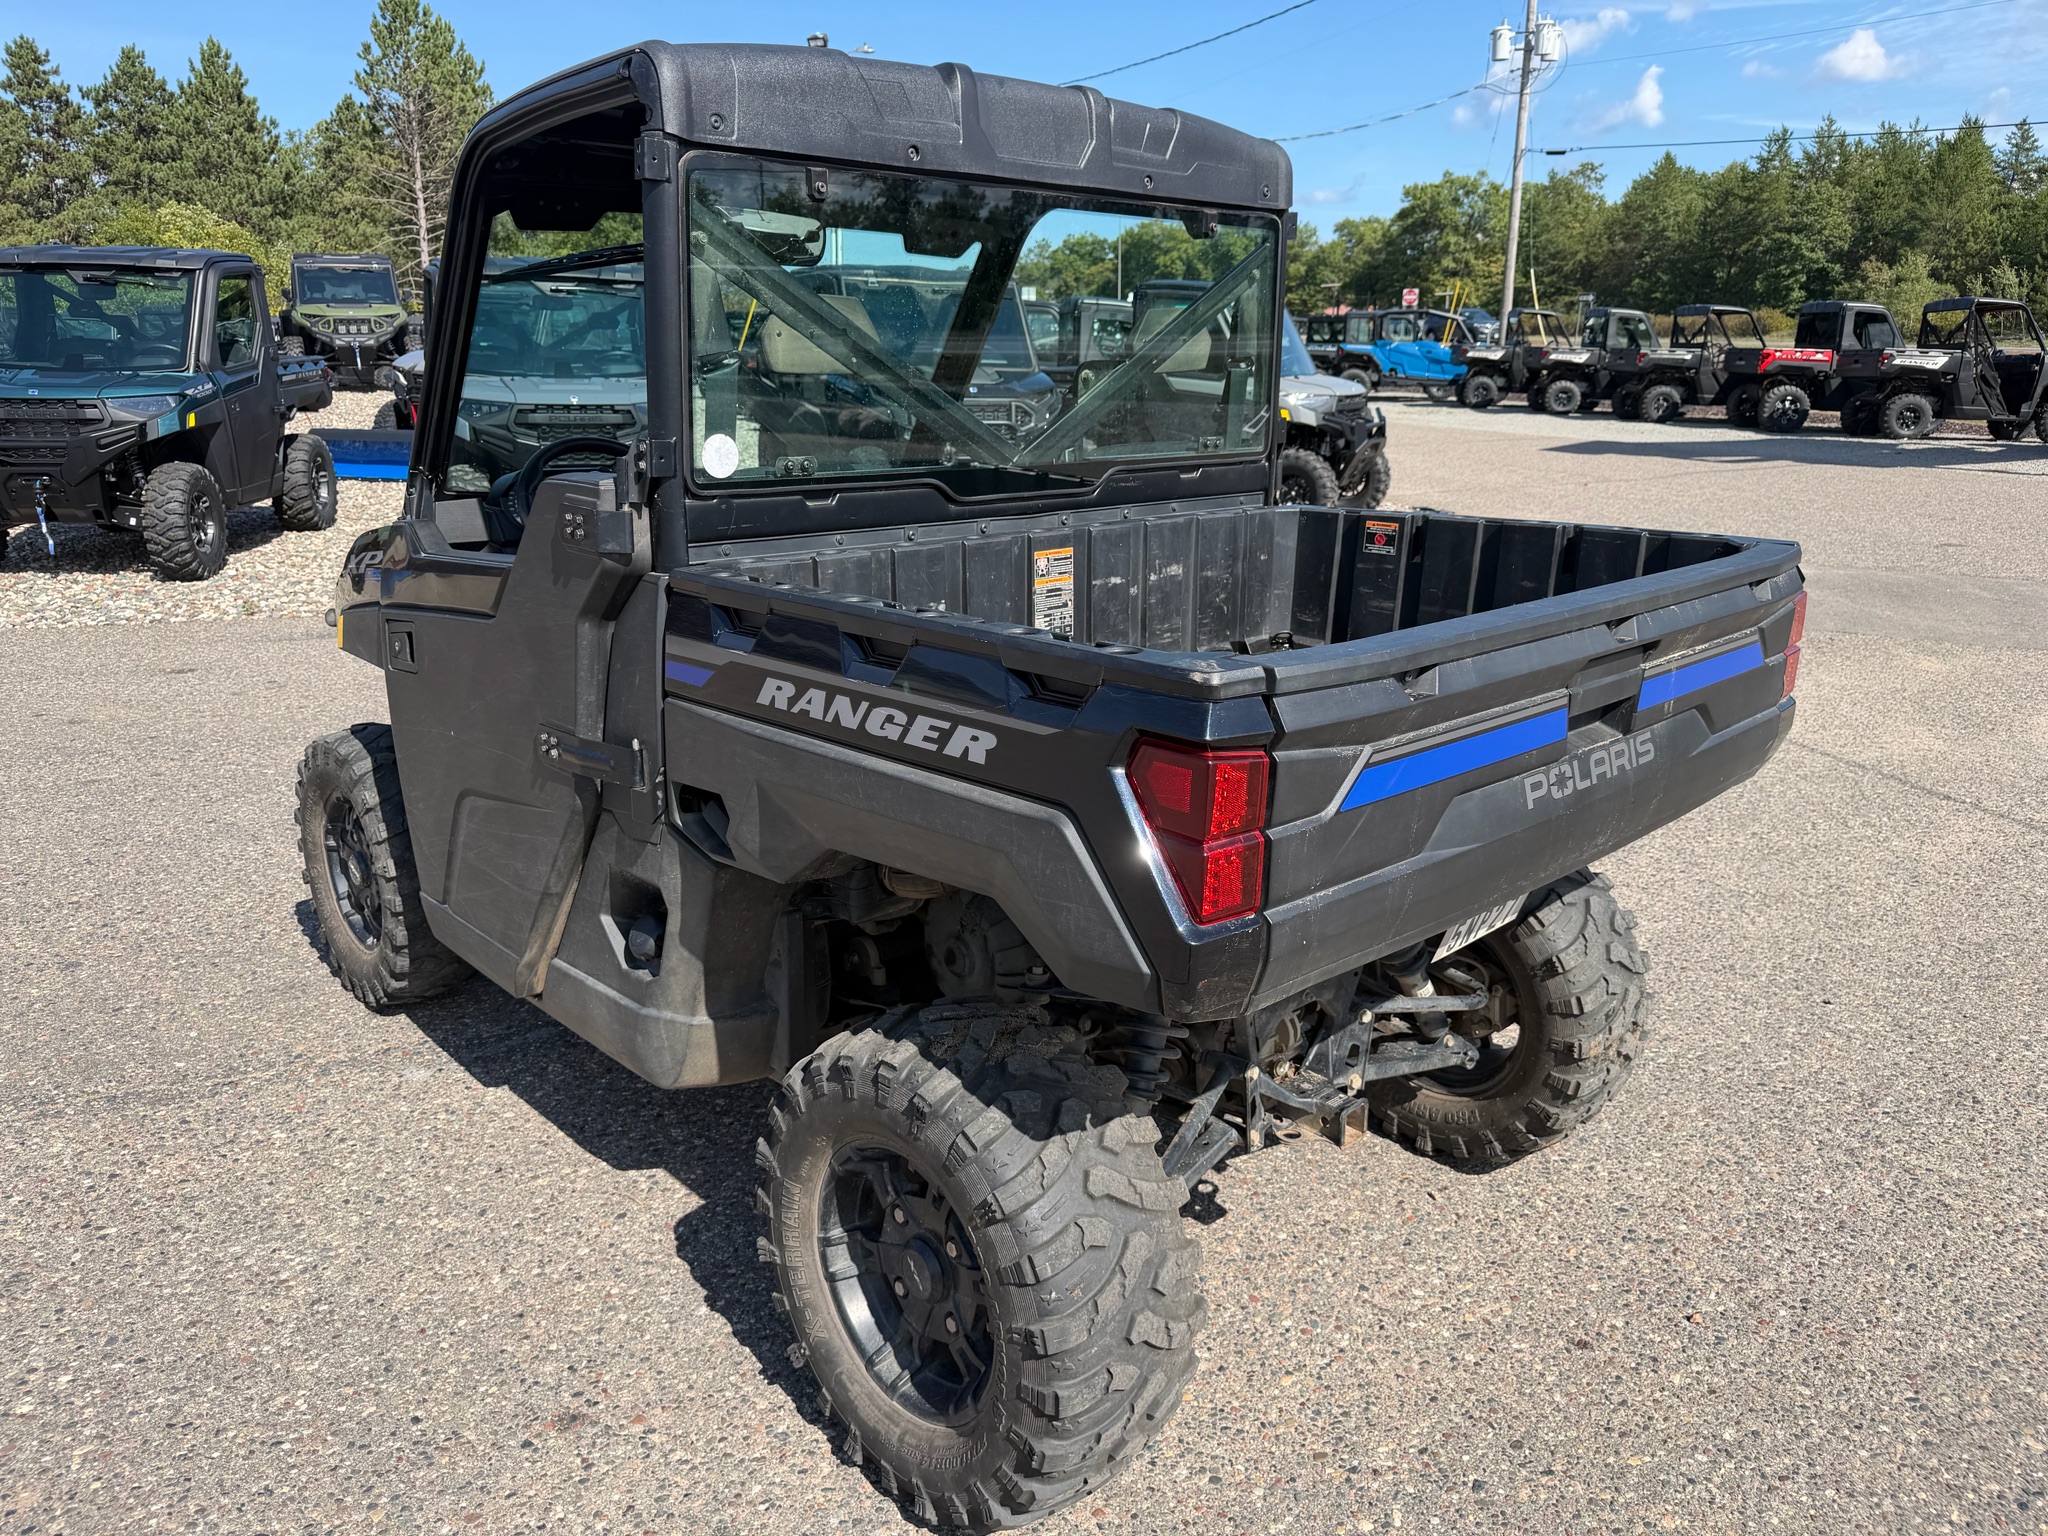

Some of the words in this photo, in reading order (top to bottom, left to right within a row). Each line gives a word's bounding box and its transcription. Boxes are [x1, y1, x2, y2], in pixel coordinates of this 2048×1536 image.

[341, 551, 384, 577] XP
[756, 677, 998, 765] RANGER
[1523, 731, 1655, 810] POLARIS
[781, 1178, 828, 1346] X-TERRAIN
